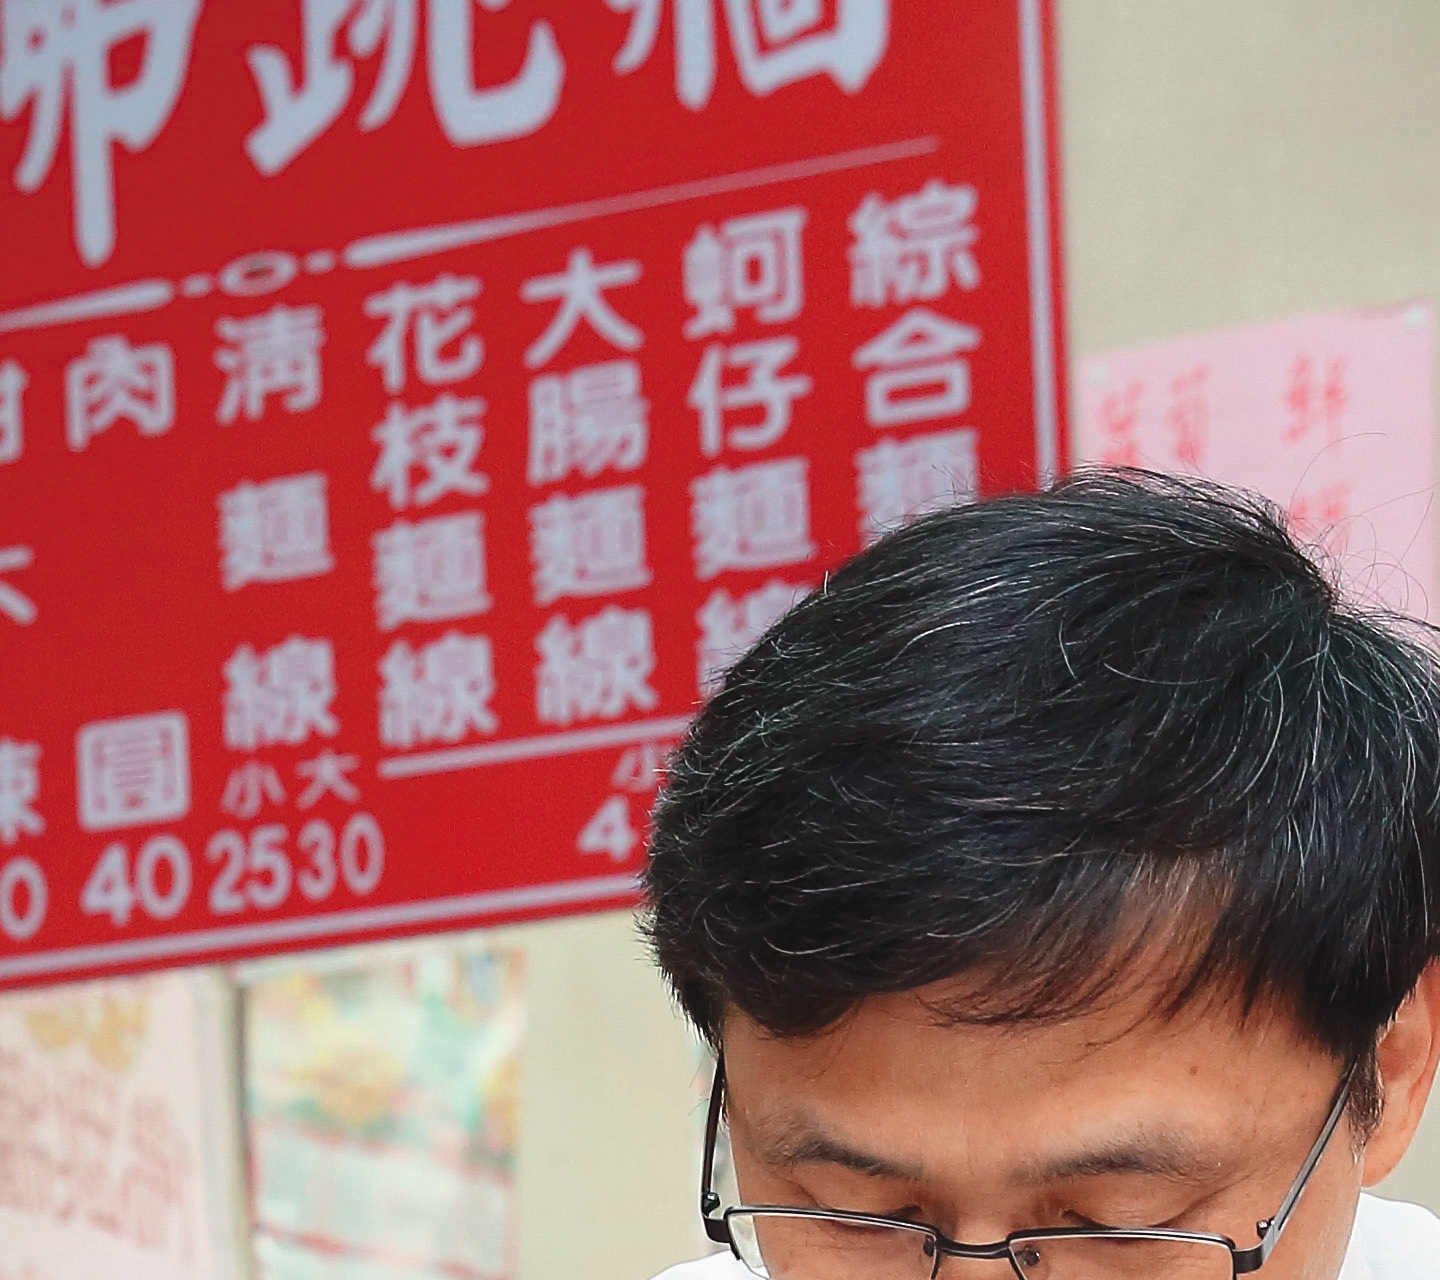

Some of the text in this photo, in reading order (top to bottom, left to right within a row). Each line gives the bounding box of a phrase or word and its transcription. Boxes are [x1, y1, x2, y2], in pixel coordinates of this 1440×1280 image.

[64, 334, 192, 832] 肉圓
[215, 304, 340, 752] 清麵線
[360, 272, 500, 750] 花枝麵線
[520, 247, 660, 727] 大腸麵線
[80, 833, 192, 926] 40
[204, 822, 291, 917] 25
[297, 811, 385, 902] 30
[221, 760, 285, 819] 小
[297, 750, 360, 809] 大
